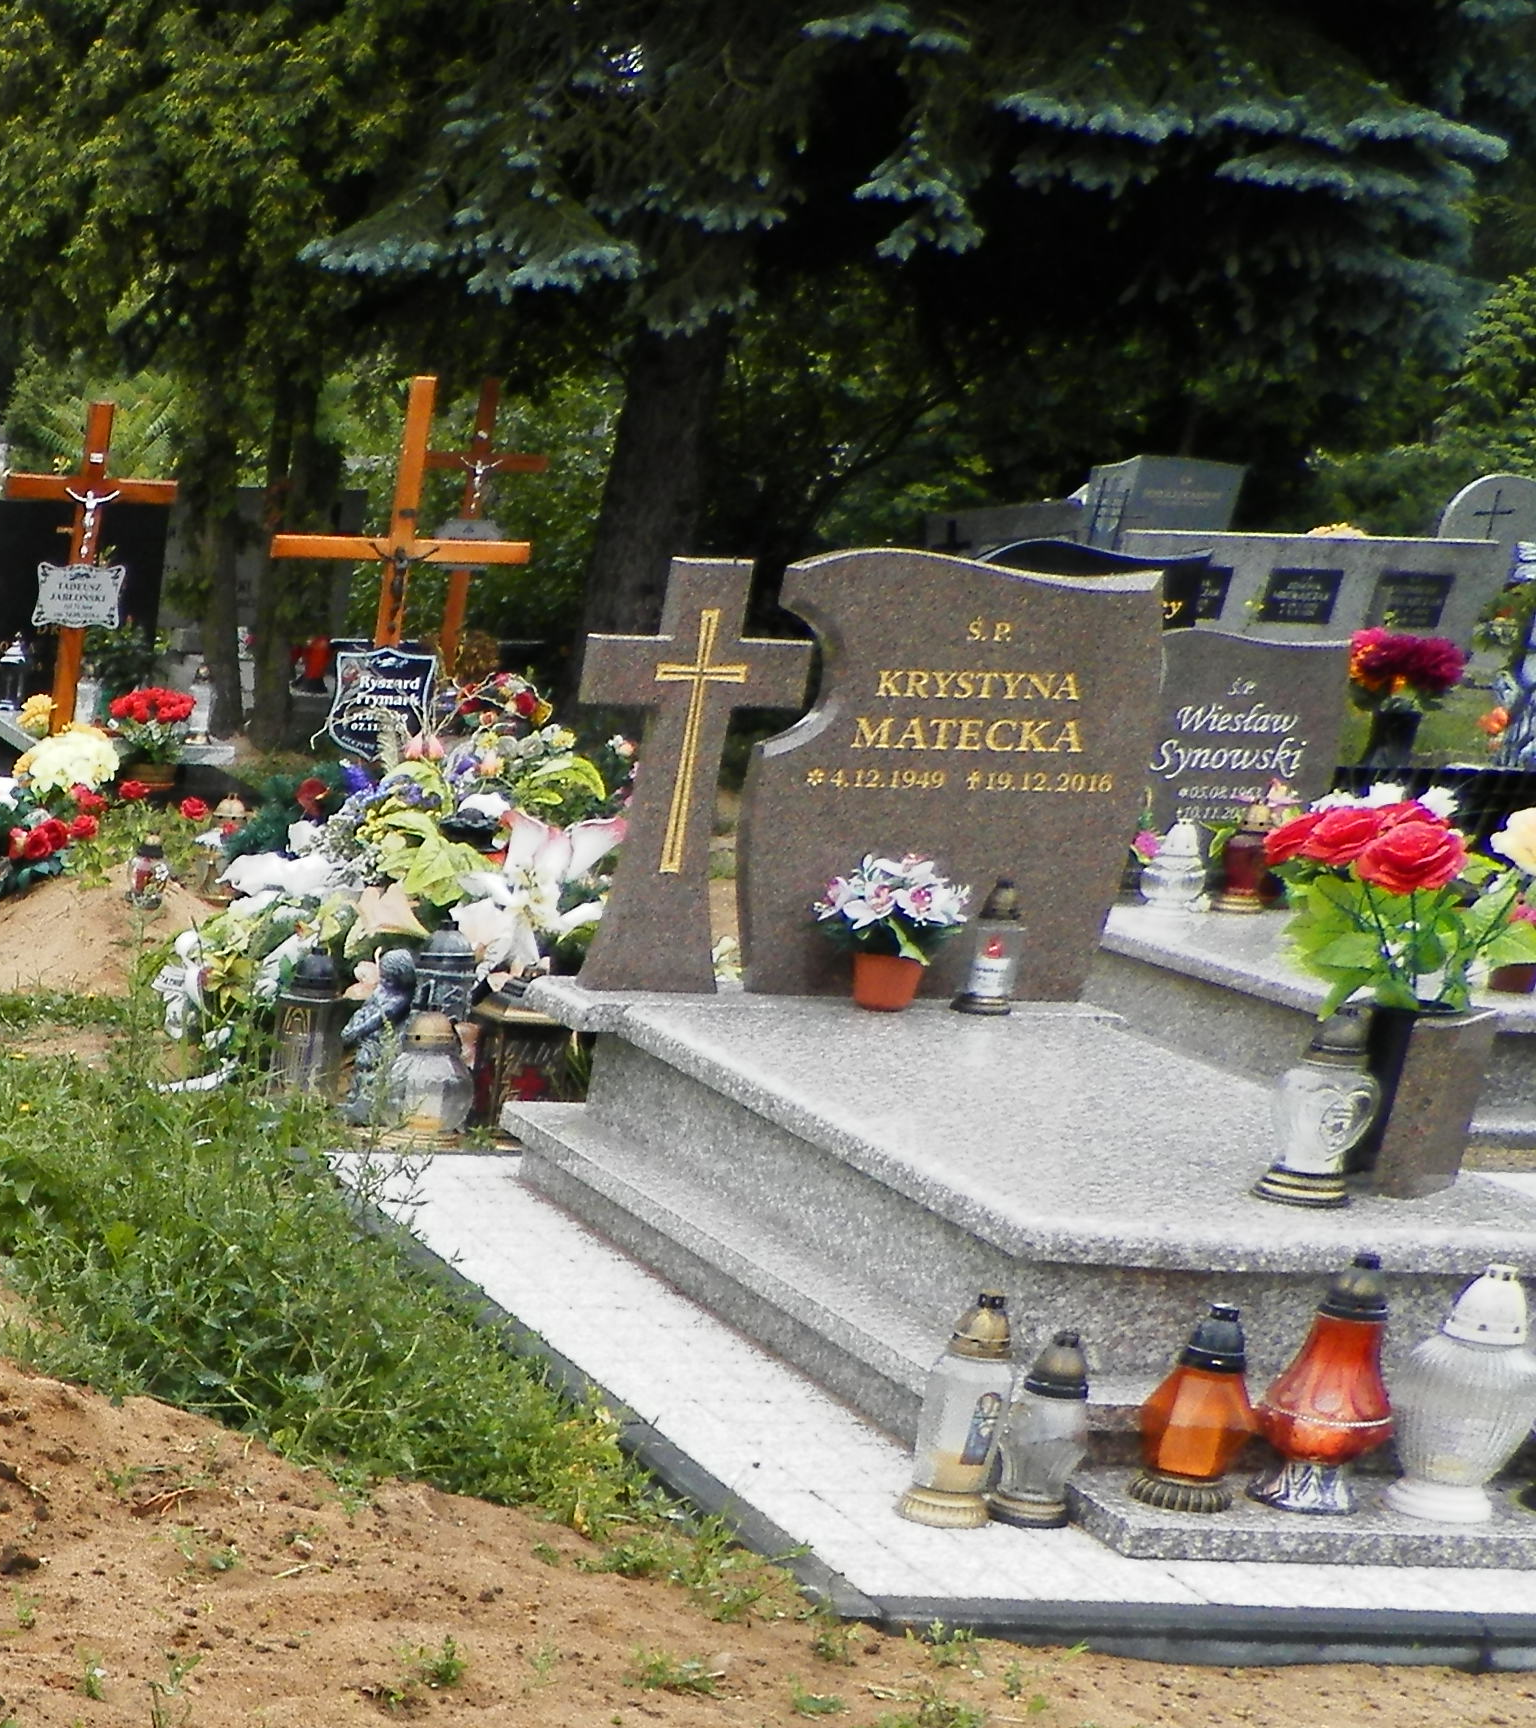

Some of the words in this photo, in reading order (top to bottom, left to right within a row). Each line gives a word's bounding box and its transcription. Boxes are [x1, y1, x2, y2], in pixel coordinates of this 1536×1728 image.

[875, 669, 1080, 701] KRYSTYNA
[1176, 703, 1300, 733] Wiesław
[850, 717, 1083, 753] MATECKA
[1150, 737, 1308, 779] Synowski
[830, 768, 946, 790] 4.12.1949
[985, 770, 1113, 793] 19.12.2016
[1183, 806, 1247, 820] 10.11.20
